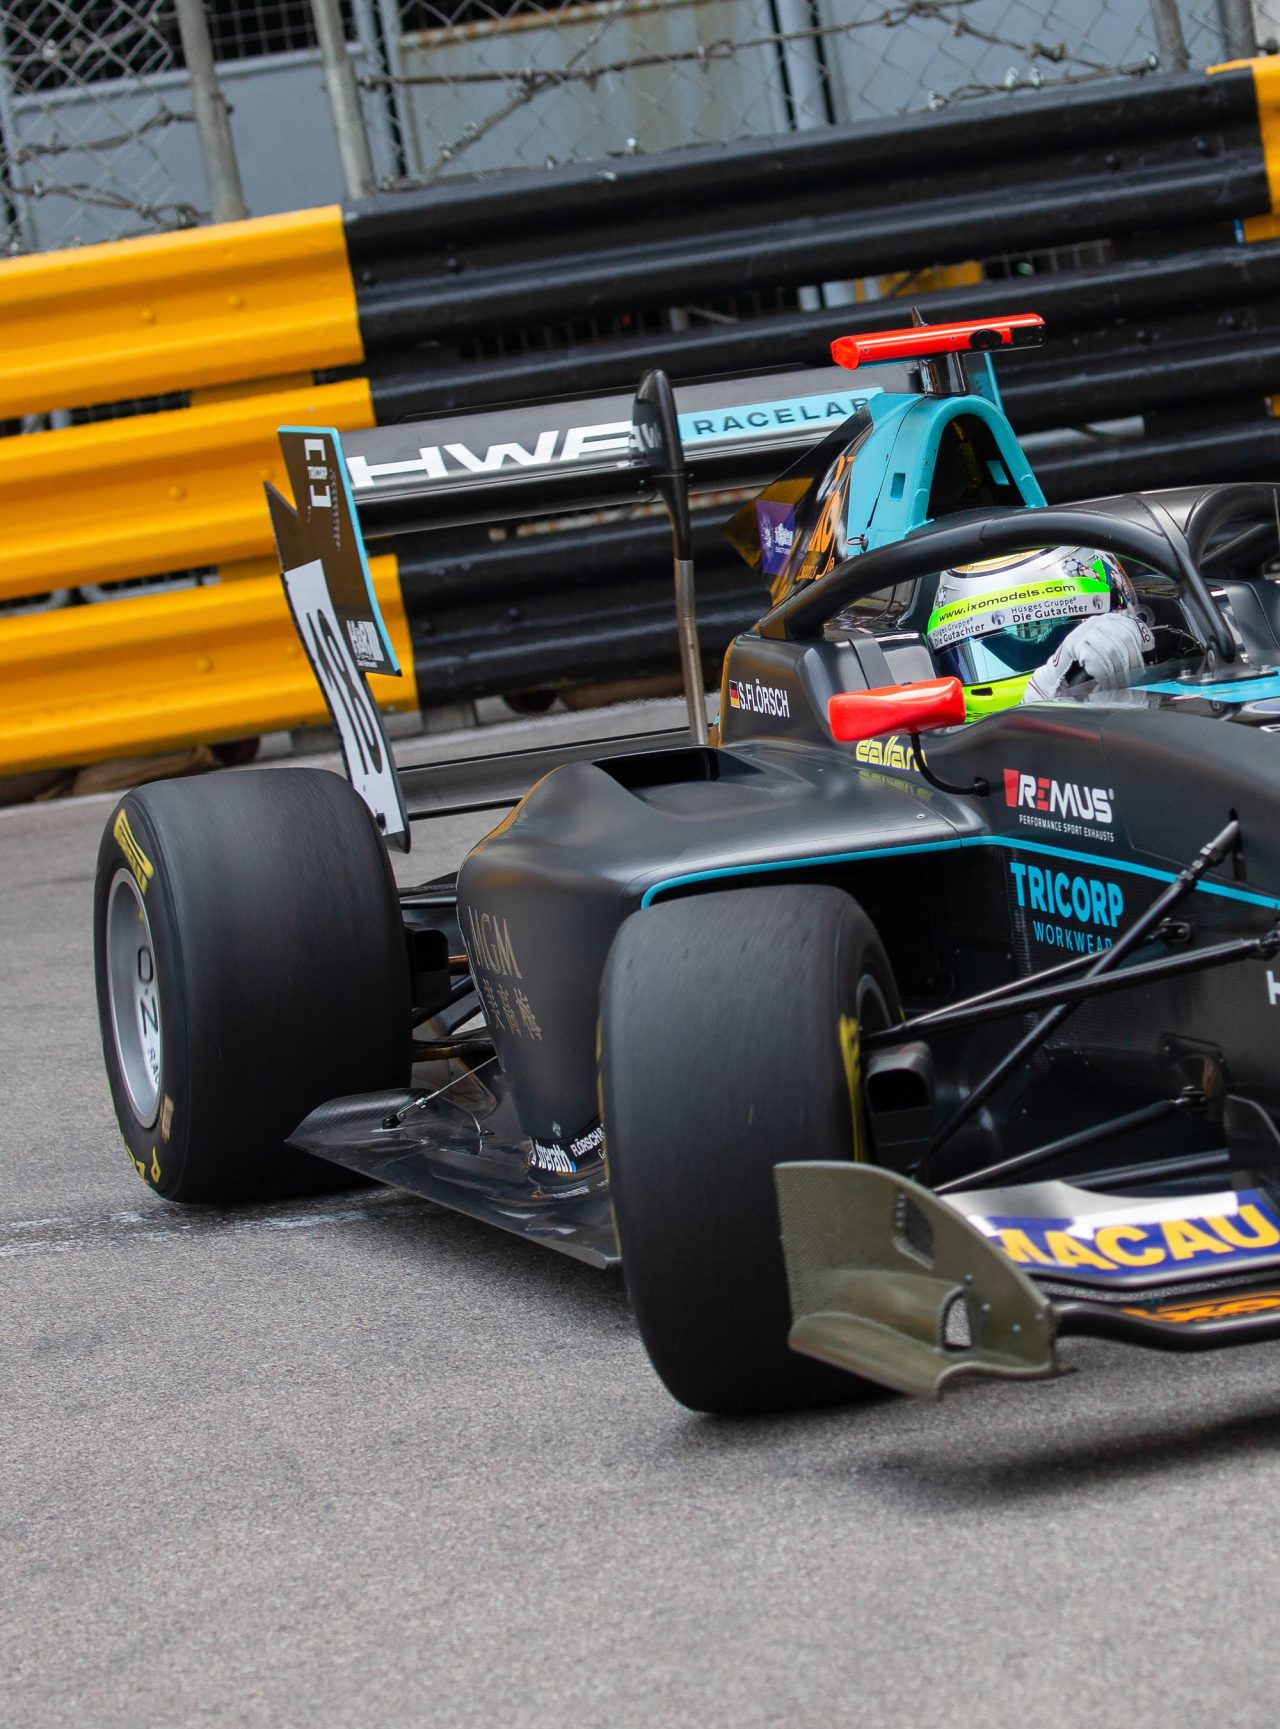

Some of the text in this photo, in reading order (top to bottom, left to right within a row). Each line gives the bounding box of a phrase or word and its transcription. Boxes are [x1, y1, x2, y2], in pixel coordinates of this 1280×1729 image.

[938, 584, 1077, 622] www.ixomodels.com
[1012, 604, 1088, 623] Die Gutachter
[943, 623, 985, 643] Gutachter
[1018, 814, 1115, 843] PERFORMANCE SPORT EXHAUSTS
[1010, 861, 1124, 928] TRICORP
